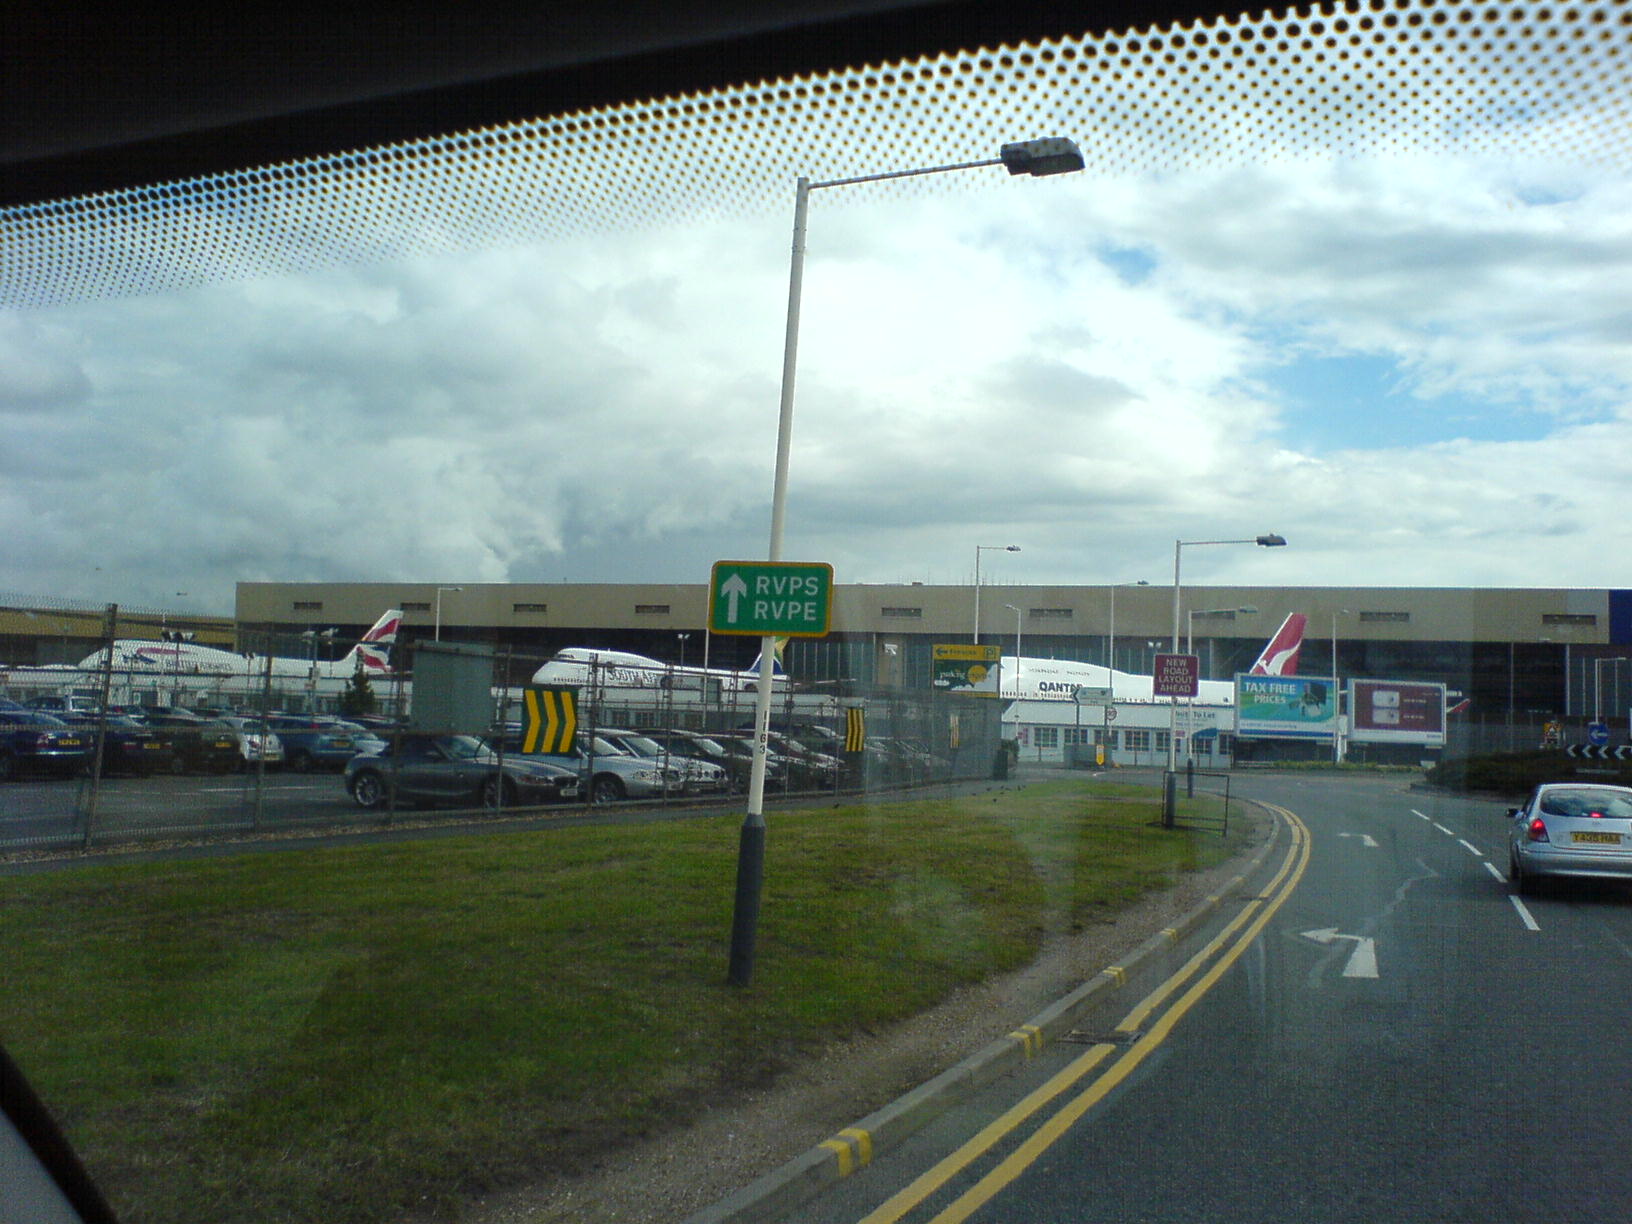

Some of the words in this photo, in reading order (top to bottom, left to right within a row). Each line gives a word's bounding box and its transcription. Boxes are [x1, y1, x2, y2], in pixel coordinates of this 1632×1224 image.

[755, 575, 819, 596] RVPS
[754, 600, 817, 621] RVPE
[1166, 658, 1187, 667] NEW
[1163, 667, 1189, 675] ROAD
[1158, 675, 1193, 684] LAYOUT
[1160, 684, 1191, 693] AHEAD
[1244, 682, 1266, 693] TAX
[1270, 683, 1297, 694] FREE
[1254, 694, 1287, 704] PRICES
